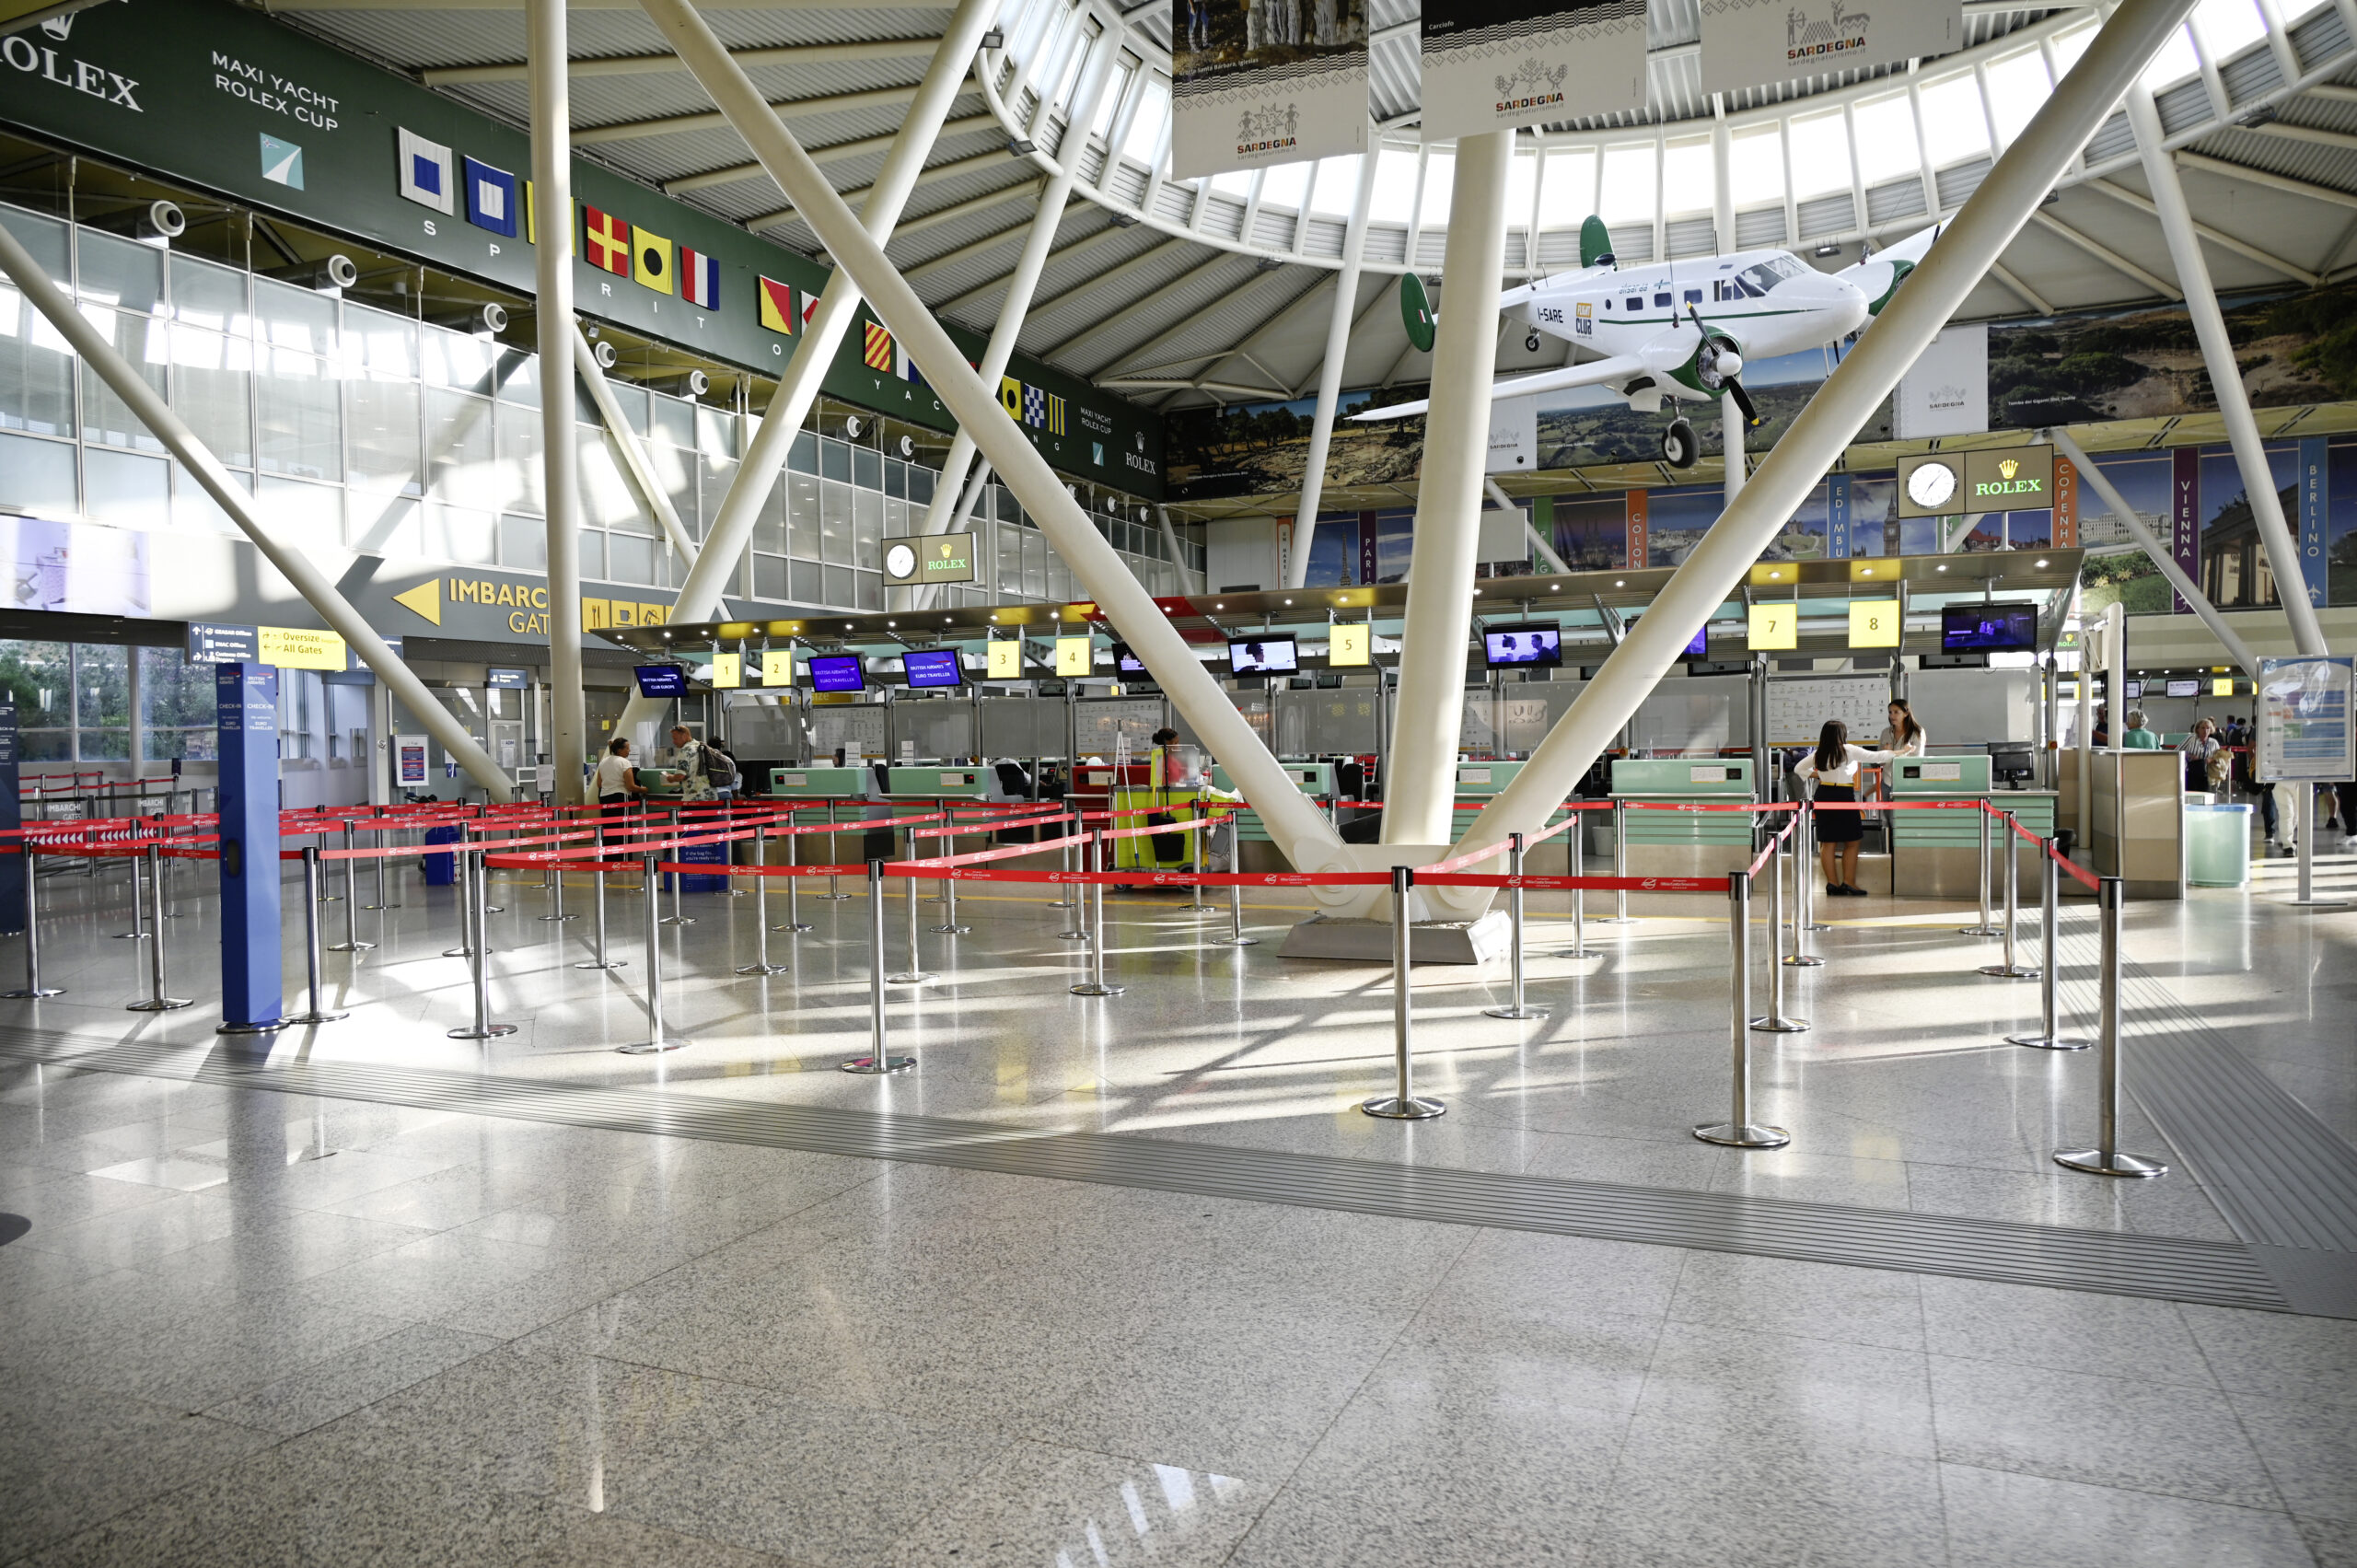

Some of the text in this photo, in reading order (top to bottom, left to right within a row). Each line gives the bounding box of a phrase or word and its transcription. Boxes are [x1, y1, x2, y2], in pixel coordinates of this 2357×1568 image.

[1428, 20, 1454, 30] Carciofo
[1787, 36, 1866, 59] SARDEGNA
[1787, 49, 1866, 67] sardegnaturismo.it
[0, 35, 144, 112] OLEX
[212, 50, 339, 113] MAXI YACHT
[215, 74, 338, 131] ROLEX CUP
[1495, 92, 1564, 112] SARDEGNA
[1496, 103, 1564, 119] sardegnaturismo.it
[1237, 137, 1296, 154] SARDEGNA
[1237, 147, 1296, 160] sardegnaturismo.it
[1537, 307, 1563, 324] I-SARE
[1576, 318, 1592, 335] CLUB
[1929, 401, 1965, 409] SARDEGNA
[1080, 407, 1111, 424] MAXI YACHT
[1082, 418, 1111, 435] ROLEX CUP
[1125, 451, 1156, 475] ROLEX
[1975, 479, 2042, 496] ROLEX
[2307, 465, 2319, 557] BERLINO
[2181, 481, 2191, 558] VIENNA
[928, 558, 966, 570] ROLEX
[449, 578, 548, 609] IMBARC
[1768, 621, 1776, 633] 7
[1869, 617, 1879, 631] 8
[283, 632, 320, 643] Oversize
[1345, 639, 1352, 650] 5
[298, 645, 323, 655] Gates
[1069, 652, 1076, 662] 4
[1000, 654, 1006, 664] 3
[724, 666, 729, 675] 1
[774, 664, 779, 674] 2
[47, 803, 81, 812] IMBARCHI
[138, 798, 163, 807] IMBARCHI
